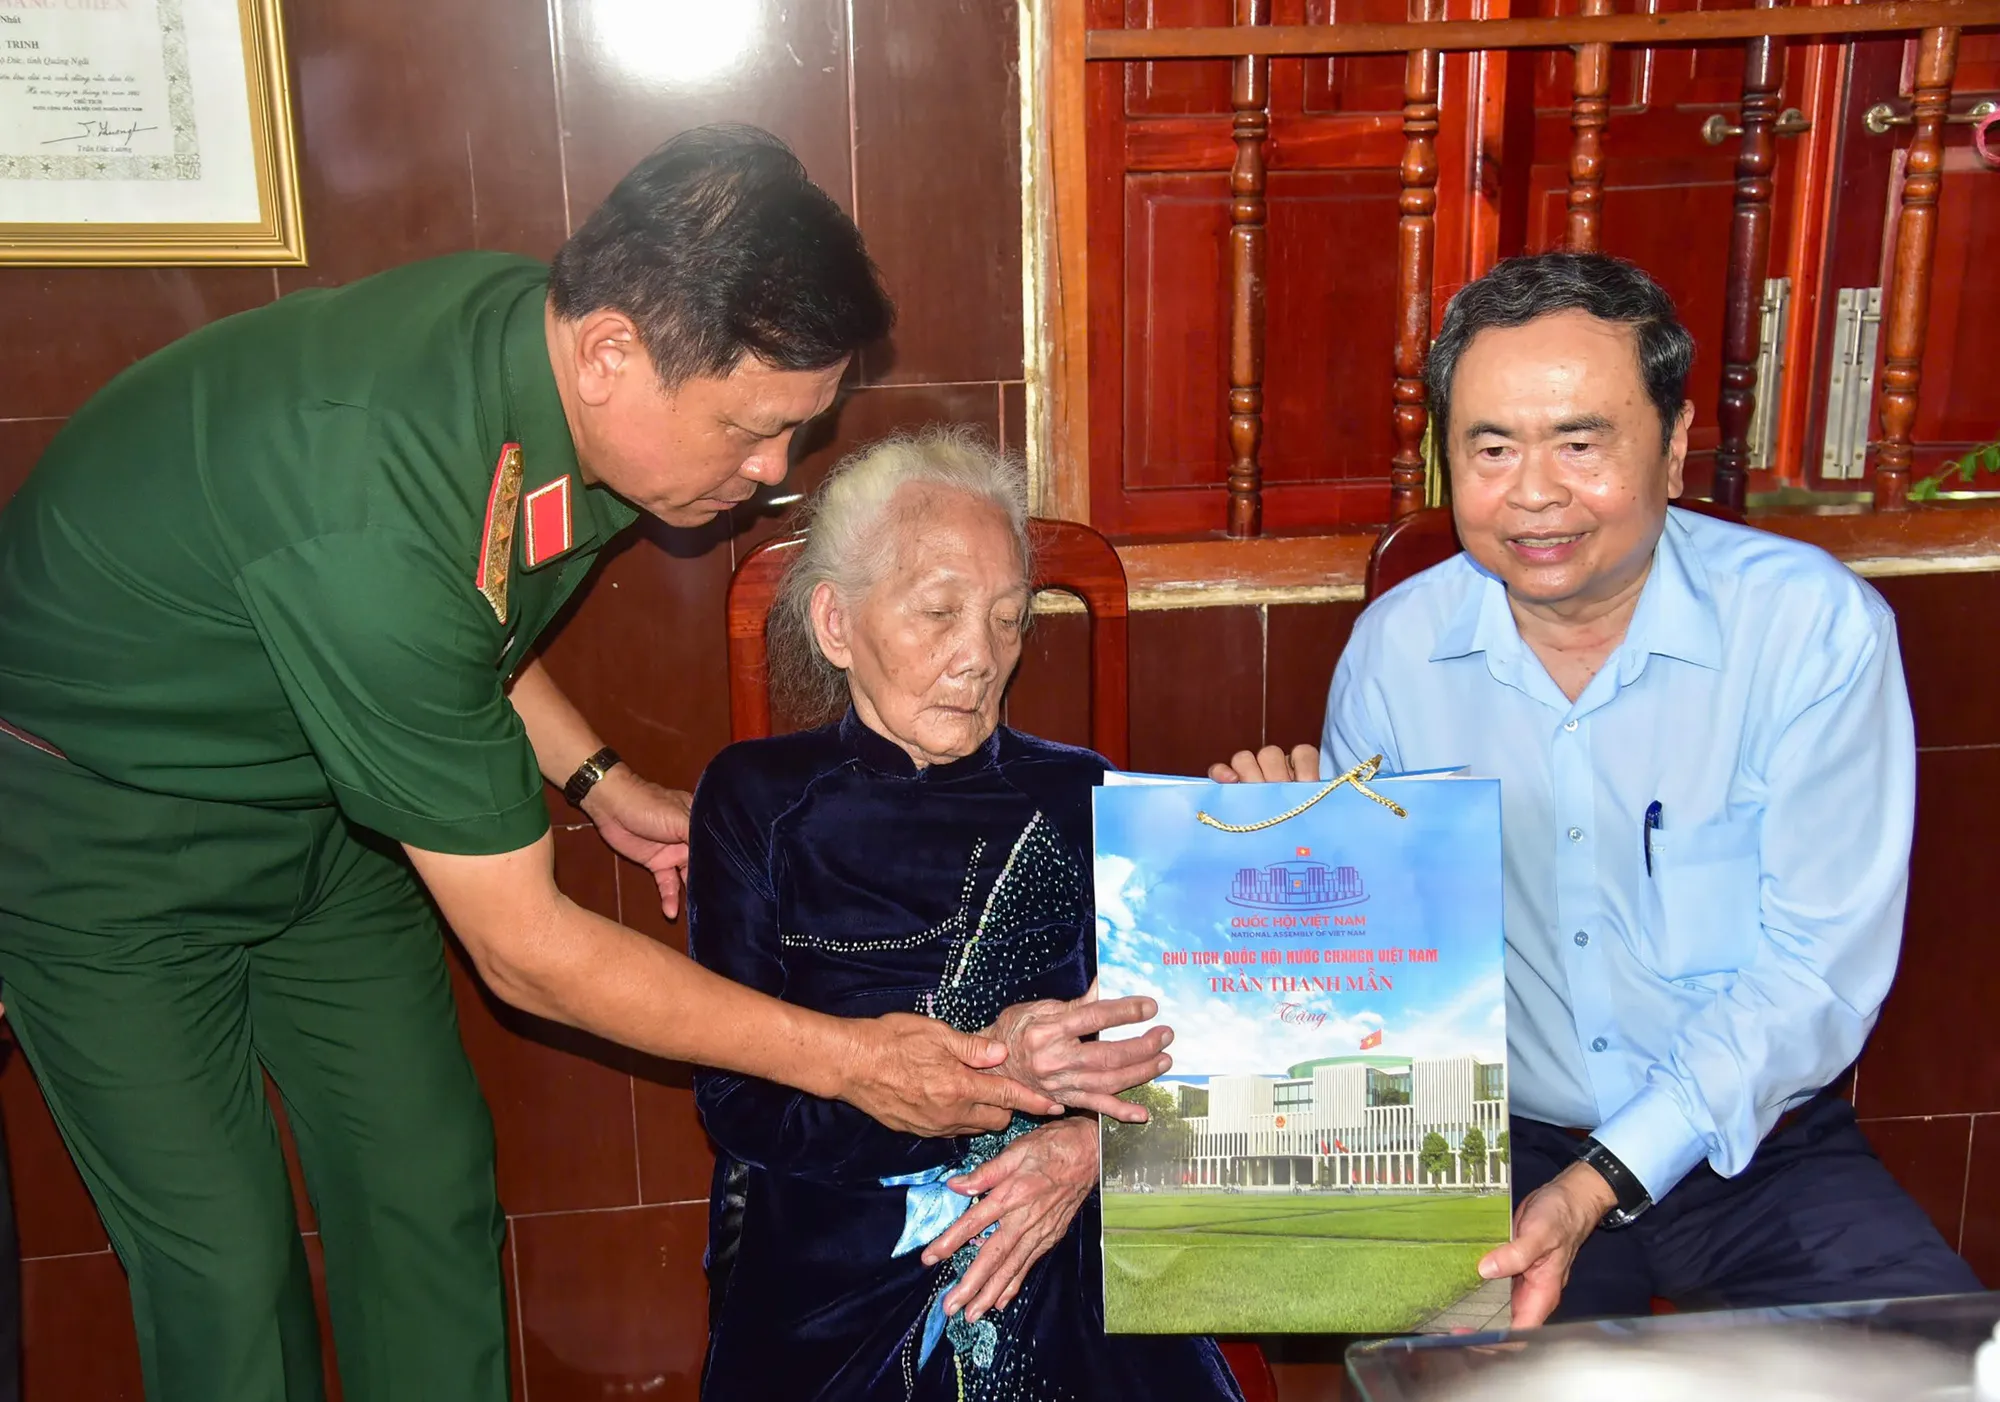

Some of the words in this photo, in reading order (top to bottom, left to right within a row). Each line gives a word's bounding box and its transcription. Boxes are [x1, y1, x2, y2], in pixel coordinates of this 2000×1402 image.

[1231, 914, 1269, 928] QUỐC
[1273, 914, 1297, 930] HỘI
[1300, 914, 1330, 929] VIỆT
[1334, 915, 1366, 927] NAM
[1273, 930, 1313, 938] ASSEMBLY
[1162, 948, 1188, 965] CHỦ
[1191, 951, 1219, 967] TỊCH
[1223, 946, 1257, 964] QUỐC
[1261, 948, 1282, 966] HỘI
[1286, 947, 1320, 964] NƯỚC
[1324, 949, 1374, 963] CHXHCN
[1378, 946, 1404, 965] VIỆT
[1408, 948, 1438, 963] NAM
[1207, 968, 1264, 992] TRẦN
[1266, 976, 1341, 992] THANH
[1346, 967, 1393, 992] MẪN
[1272, 1001, 1328, 1031] Tặng
